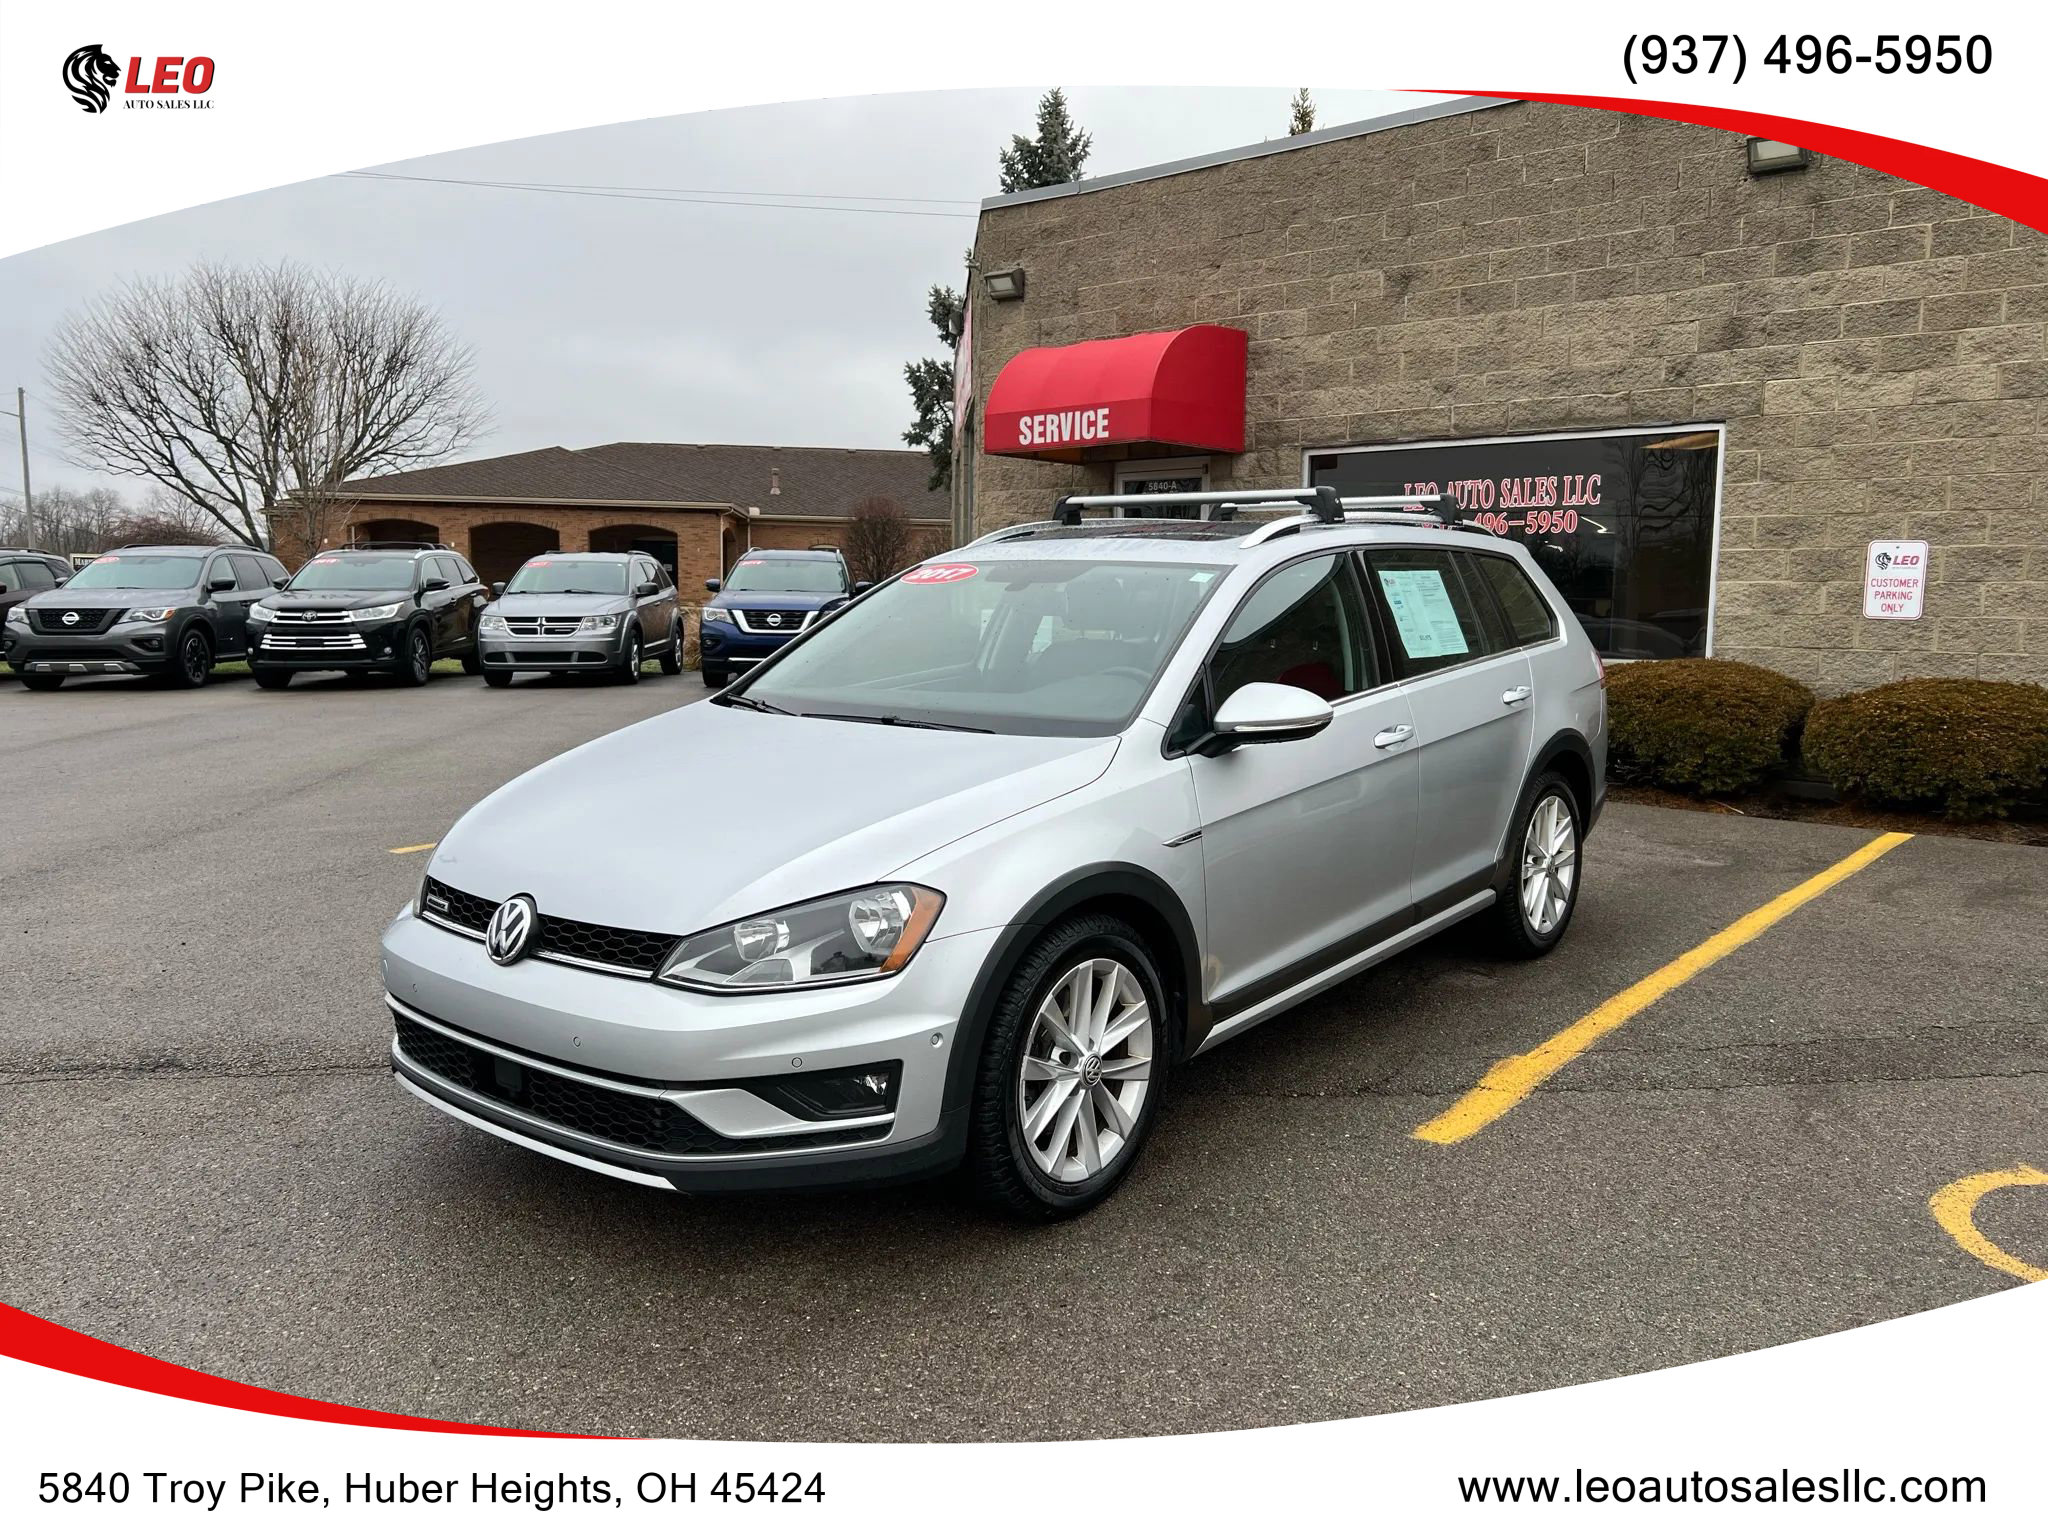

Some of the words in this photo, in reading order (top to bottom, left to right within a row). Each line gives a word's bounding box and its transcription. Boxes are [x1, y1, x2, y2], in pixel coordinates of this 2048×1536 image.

[1018, 408, 1110, 446] SERVICE
[1500, 476, 1558, 509] SALES
[1562, 474, 1602, 506] LLC
[1892, 555, 1920, 566] LEO
[1870, 578, 1919, 588] CUSTOMER
[1874, 590, 1913, 601] PARKING
[1881, 603, 1904, 613] ONLY
